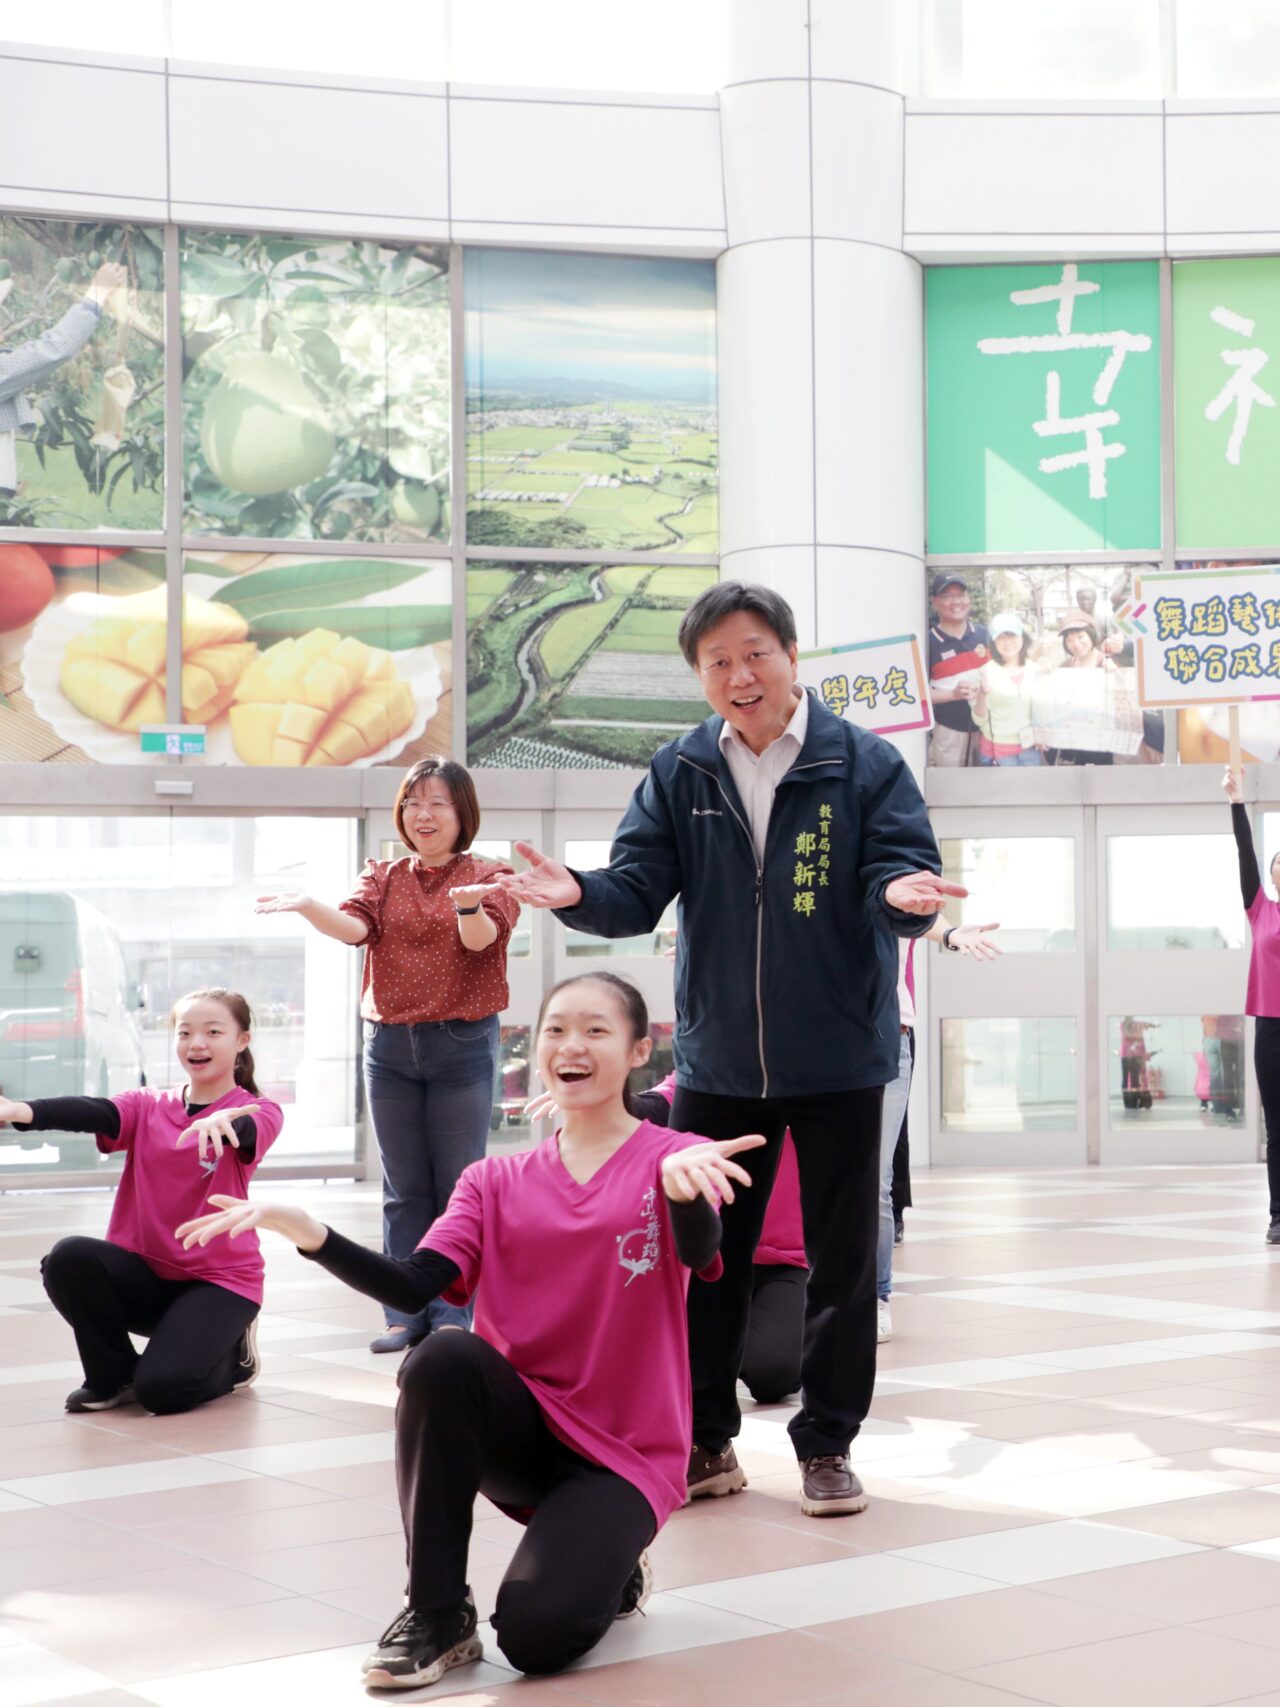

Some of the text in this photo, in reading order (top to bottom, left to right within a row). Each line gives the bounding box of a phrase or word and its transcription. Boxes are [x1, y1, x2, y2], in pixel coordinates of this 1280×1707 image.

[808, 666, 916, 716] 學年度
[794, 832, 816, 917] 鄭新輝
[818, 804, 832, 886] 教育局局長
